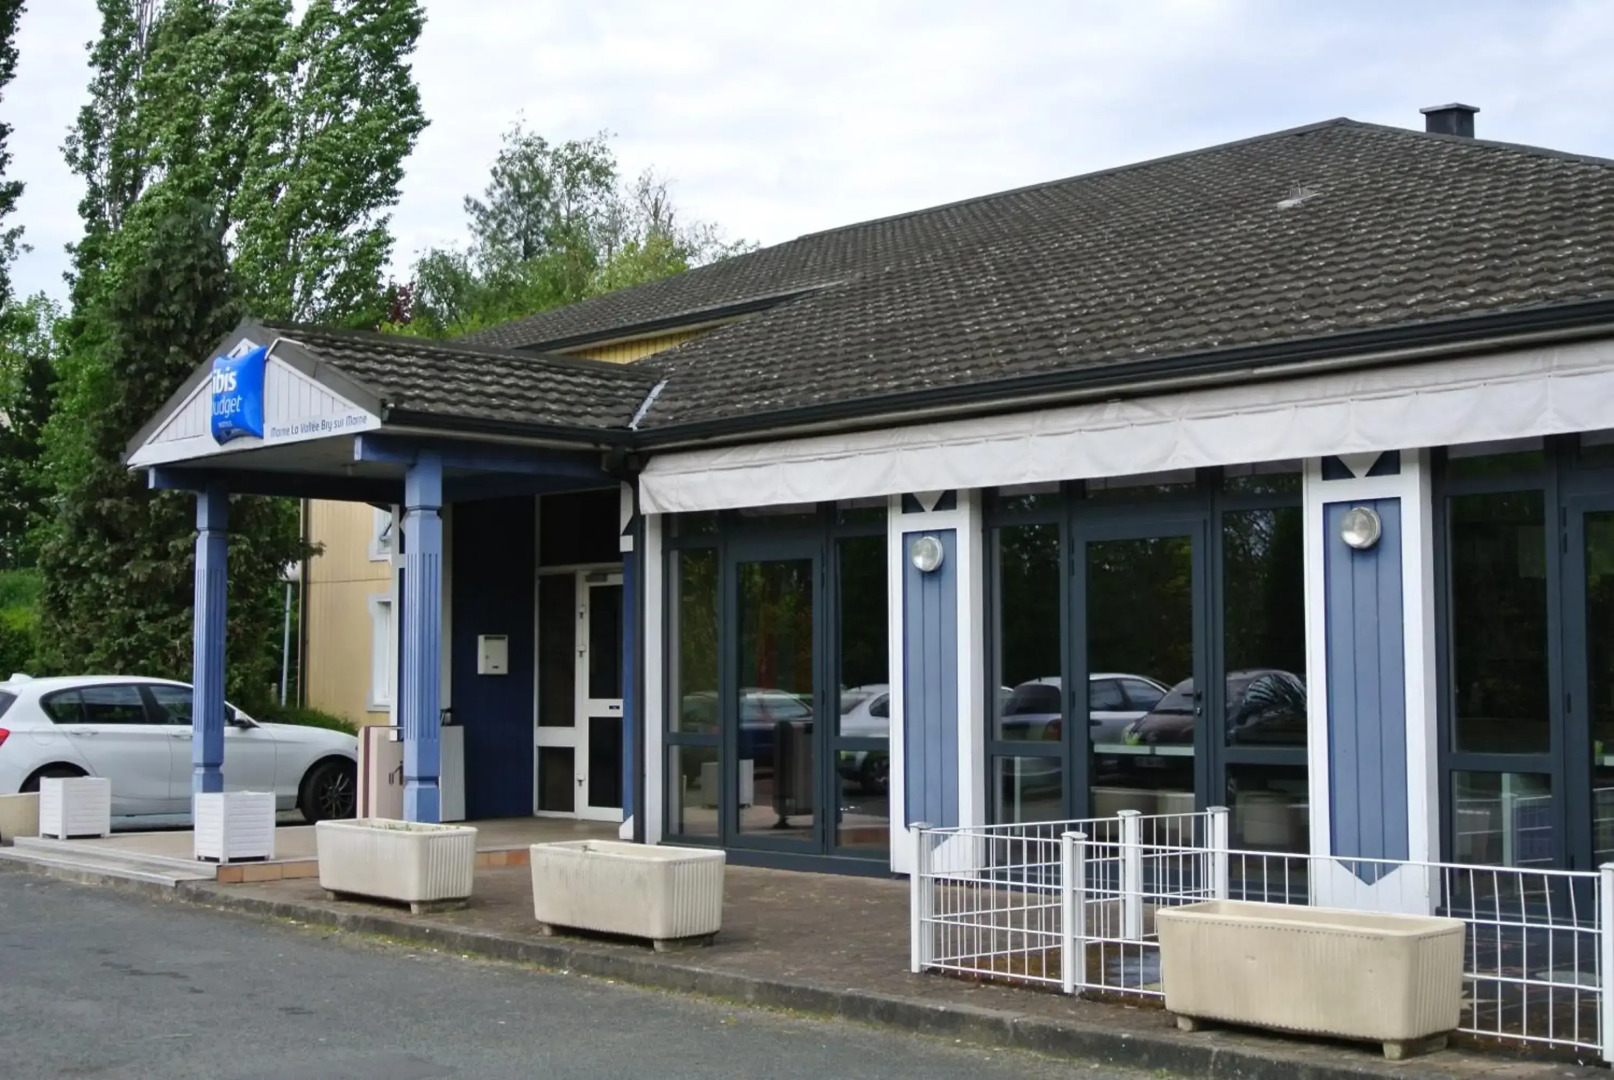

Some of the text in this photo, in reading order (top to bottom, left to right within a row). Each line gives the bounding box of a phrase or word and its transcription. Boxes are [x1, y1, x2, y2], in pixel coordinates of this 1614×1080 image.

[212, 366, 237, 394] ibis
[212, 395, 242, 418] udget
[291, 424, 299, 434] La
[300, 421, 319, 433] Vallée
[321, 419, 333, 431] Bry
[334, 418, 344, 429] sur
[345, 415, 367, 426] Marne
